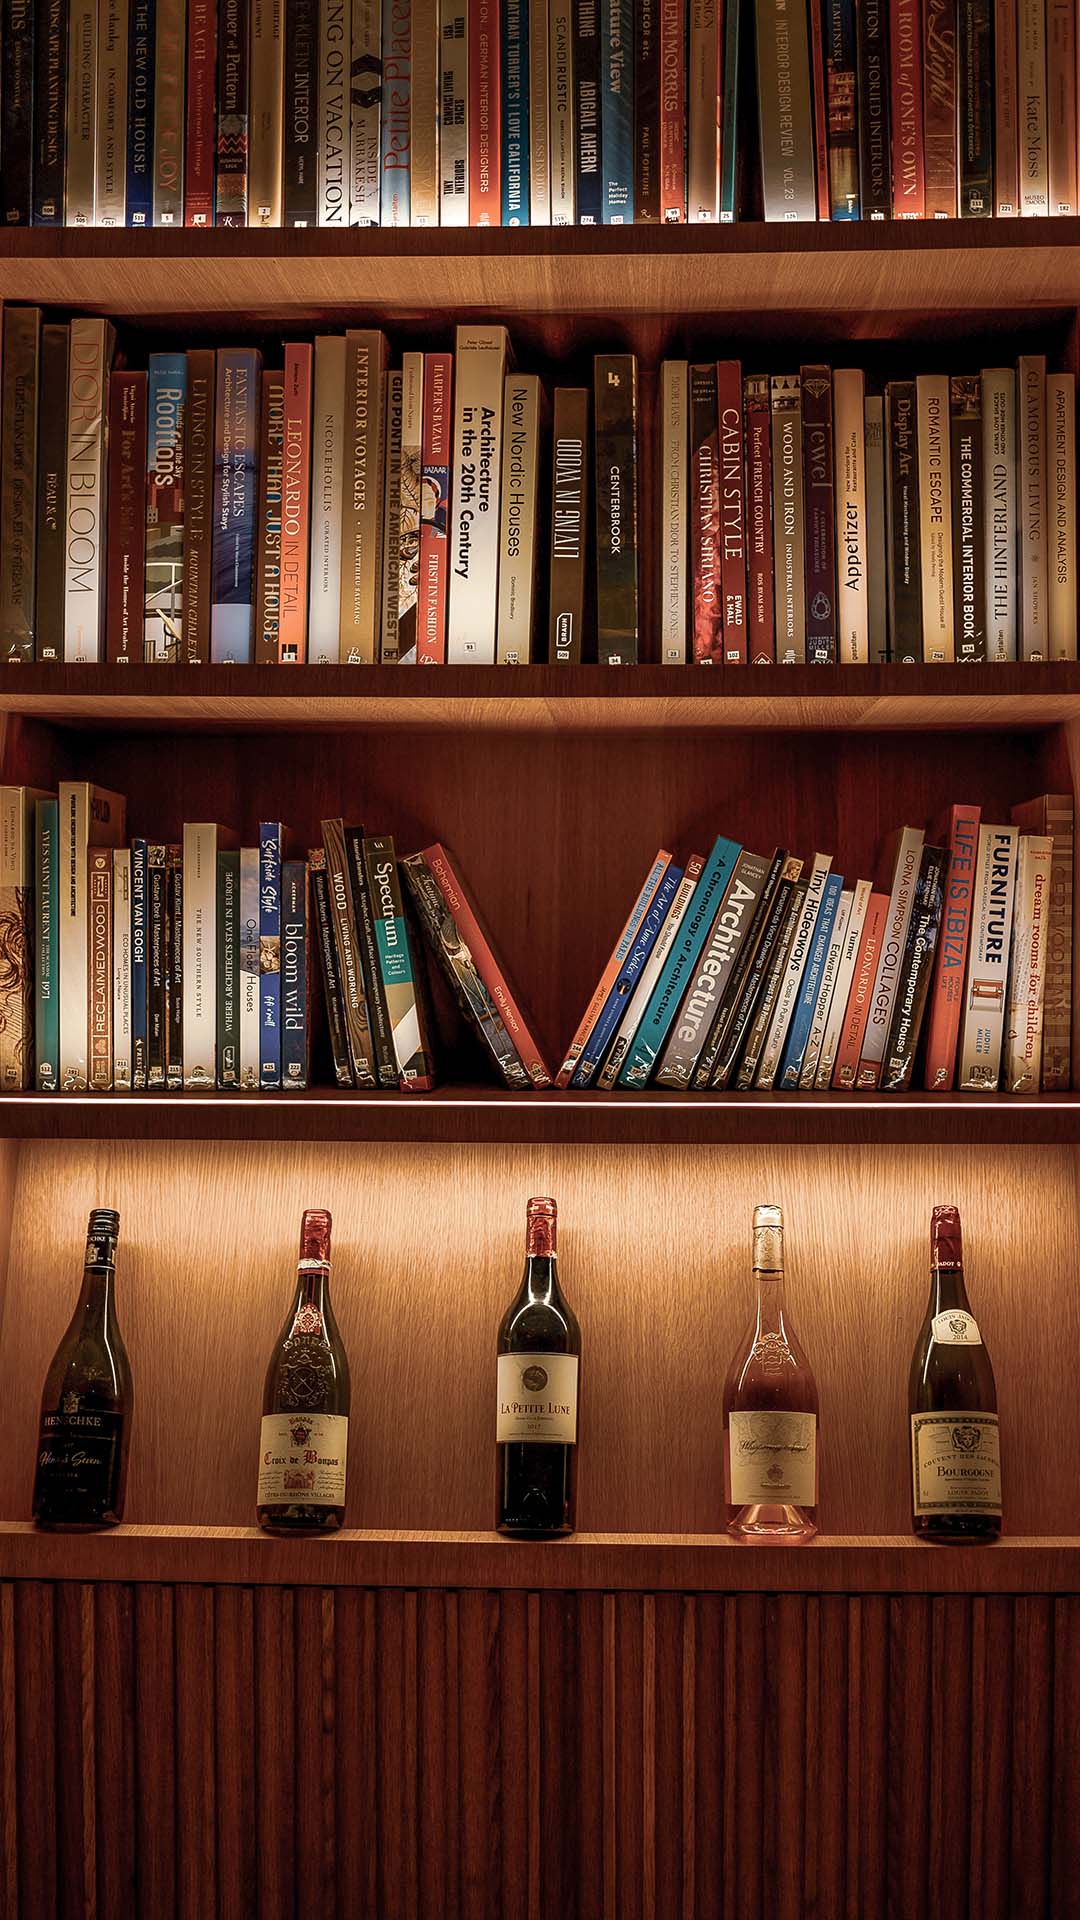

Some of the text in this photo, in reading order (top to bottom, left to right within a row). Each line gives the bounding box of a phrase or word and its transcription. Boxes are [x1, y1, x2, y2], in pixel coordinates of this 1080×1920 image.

[80, 13, 92, 142] BUILDING CHARACTER
[133, 5, 148, 175] THE NEW OLD HOUSE
[294, 71, 312, 145] INTERIOR
[507, 44, 520, 99] TURNER'S
[579, 0, 598, 173] THING ABIGAIL AHERN
[609, 50, 625, 94] View
[662, 39, 679, 112] MORRIS
[897, 12, 917, 196] ROOM of ONE'S OWN
[924, 14, 956, 112] Light
[104, 67, 116, 194] IN COMFORT AND STYLE
[325, 50, 344, 223] ON VACATION
[383, 90, 411, 173] Petite
[454, 99, 465, 125] SPACES
[479, 33, 489, 193] GERMAN INTERIOR DESIGNERS
[507, 111, 520, 139] LOVE
[868, 55, 883, 197] STORIED INTERIORS
[1025, 95, 1042, 132] Kate
[1026, 136, 1042, 178] Moss
[159, 148, 178, 192] JOY
[355, 119, 367, 204] MARRAKESH
[367, 136, 378, 184] INSIDE
[443, 179, 453, 195] TINY
[455, 159, 465, 195] INTERIORS
[508, 142, 521, 211] CALIFORNIA
[153, 387, 184, 487] Rooftops
[232, 367, 249, 518] FANTASTIC ESCAPES
[353, 346, 370, 512] INTERIOR VOYAGES
[431, 363, 445, 455] HARPER'S BAZAAR
[801, 419, 832, 490] jewel
[67, 343, 100, 594] DIOR IN BLOOM
[453, 407, 478, 580] in the 20th Century
[478, 406, 497, 513] Architecture
[721, 408, 743, 561] CABIN STYLE
[752, 427, 765, 555] Perfect FRENCH COUNTRY
[927, 396, 944, 524] ROMANTIC ESCAPE
[1055, 388, 1069, 585] APARTMENT DESIGN AND ANALYSIS
[282, 418, 304, 619] LEONARDO IN DETAIL
[609, 464, 622, 555] CENTERBROOK
[699, 444, 715, 603] CHRISTIAN SIRIANO
[782, 420, 796, 638] WOOD AND IRON INDUSTRIAL INTERIORS
[843, 501, 863, 592] Appetizer
[960, 435, 976, 639] THE COMMERCIAL INTERIOR BOOK
[122, 554, 130, 572] Inside
[122, 574, 130, 585] the
[122, 586, 130, 608] Homes
[121, 627, 130, 652] Dealers
[726, 594, 735, 626] & HALL
[733, 594, 743, 626] EWALD
[133, 848, 145, 964] VINCENT VAN GOGH
[152, 873, 161, 901] Gustave
[373, 861, 399, 947] Spectrum
[670, 861, 702, 920] 50 BUILDINGS
[788, 868, 828, 972] Tiny Hideaways
[942, 819, 977, 970] LIFE IS IBIZA
[984, 833, 1012, 965] FURNITURE
[151, 923, 162, 967] Masterpieces
[153, 967, 161, 975] of
[153, 976, 161, 987] Art
[194, 908, 203, 1018] THE NEW SOUTHERN STYLE
[246, 918, 257, 1013] One Floor Houses
[651, 858, 727, 1026] A Chronology of Architecture
[677, 878, 757, 1043] Architecture
[845, 929, 861, 961] Turner
[871, 848, 917, 1026] LORNA SIMPSON COLLAGES
[1023, 872, 1047, 1059] dream rooms for children
[41, 981, 51, 999] 1971
[845, 938, 878, 1049] LEONARDO IN DETAIL
[895, 914, 931, 1054] The Contemporary House
[974, 1028, 985, 1055] MILLER
[982, 1028, 992, 1055] JUDITH
[44, 1416, 101, 1427] HENCHKE
[501, 1402, 570, 1416] LA PETITE LUNE
